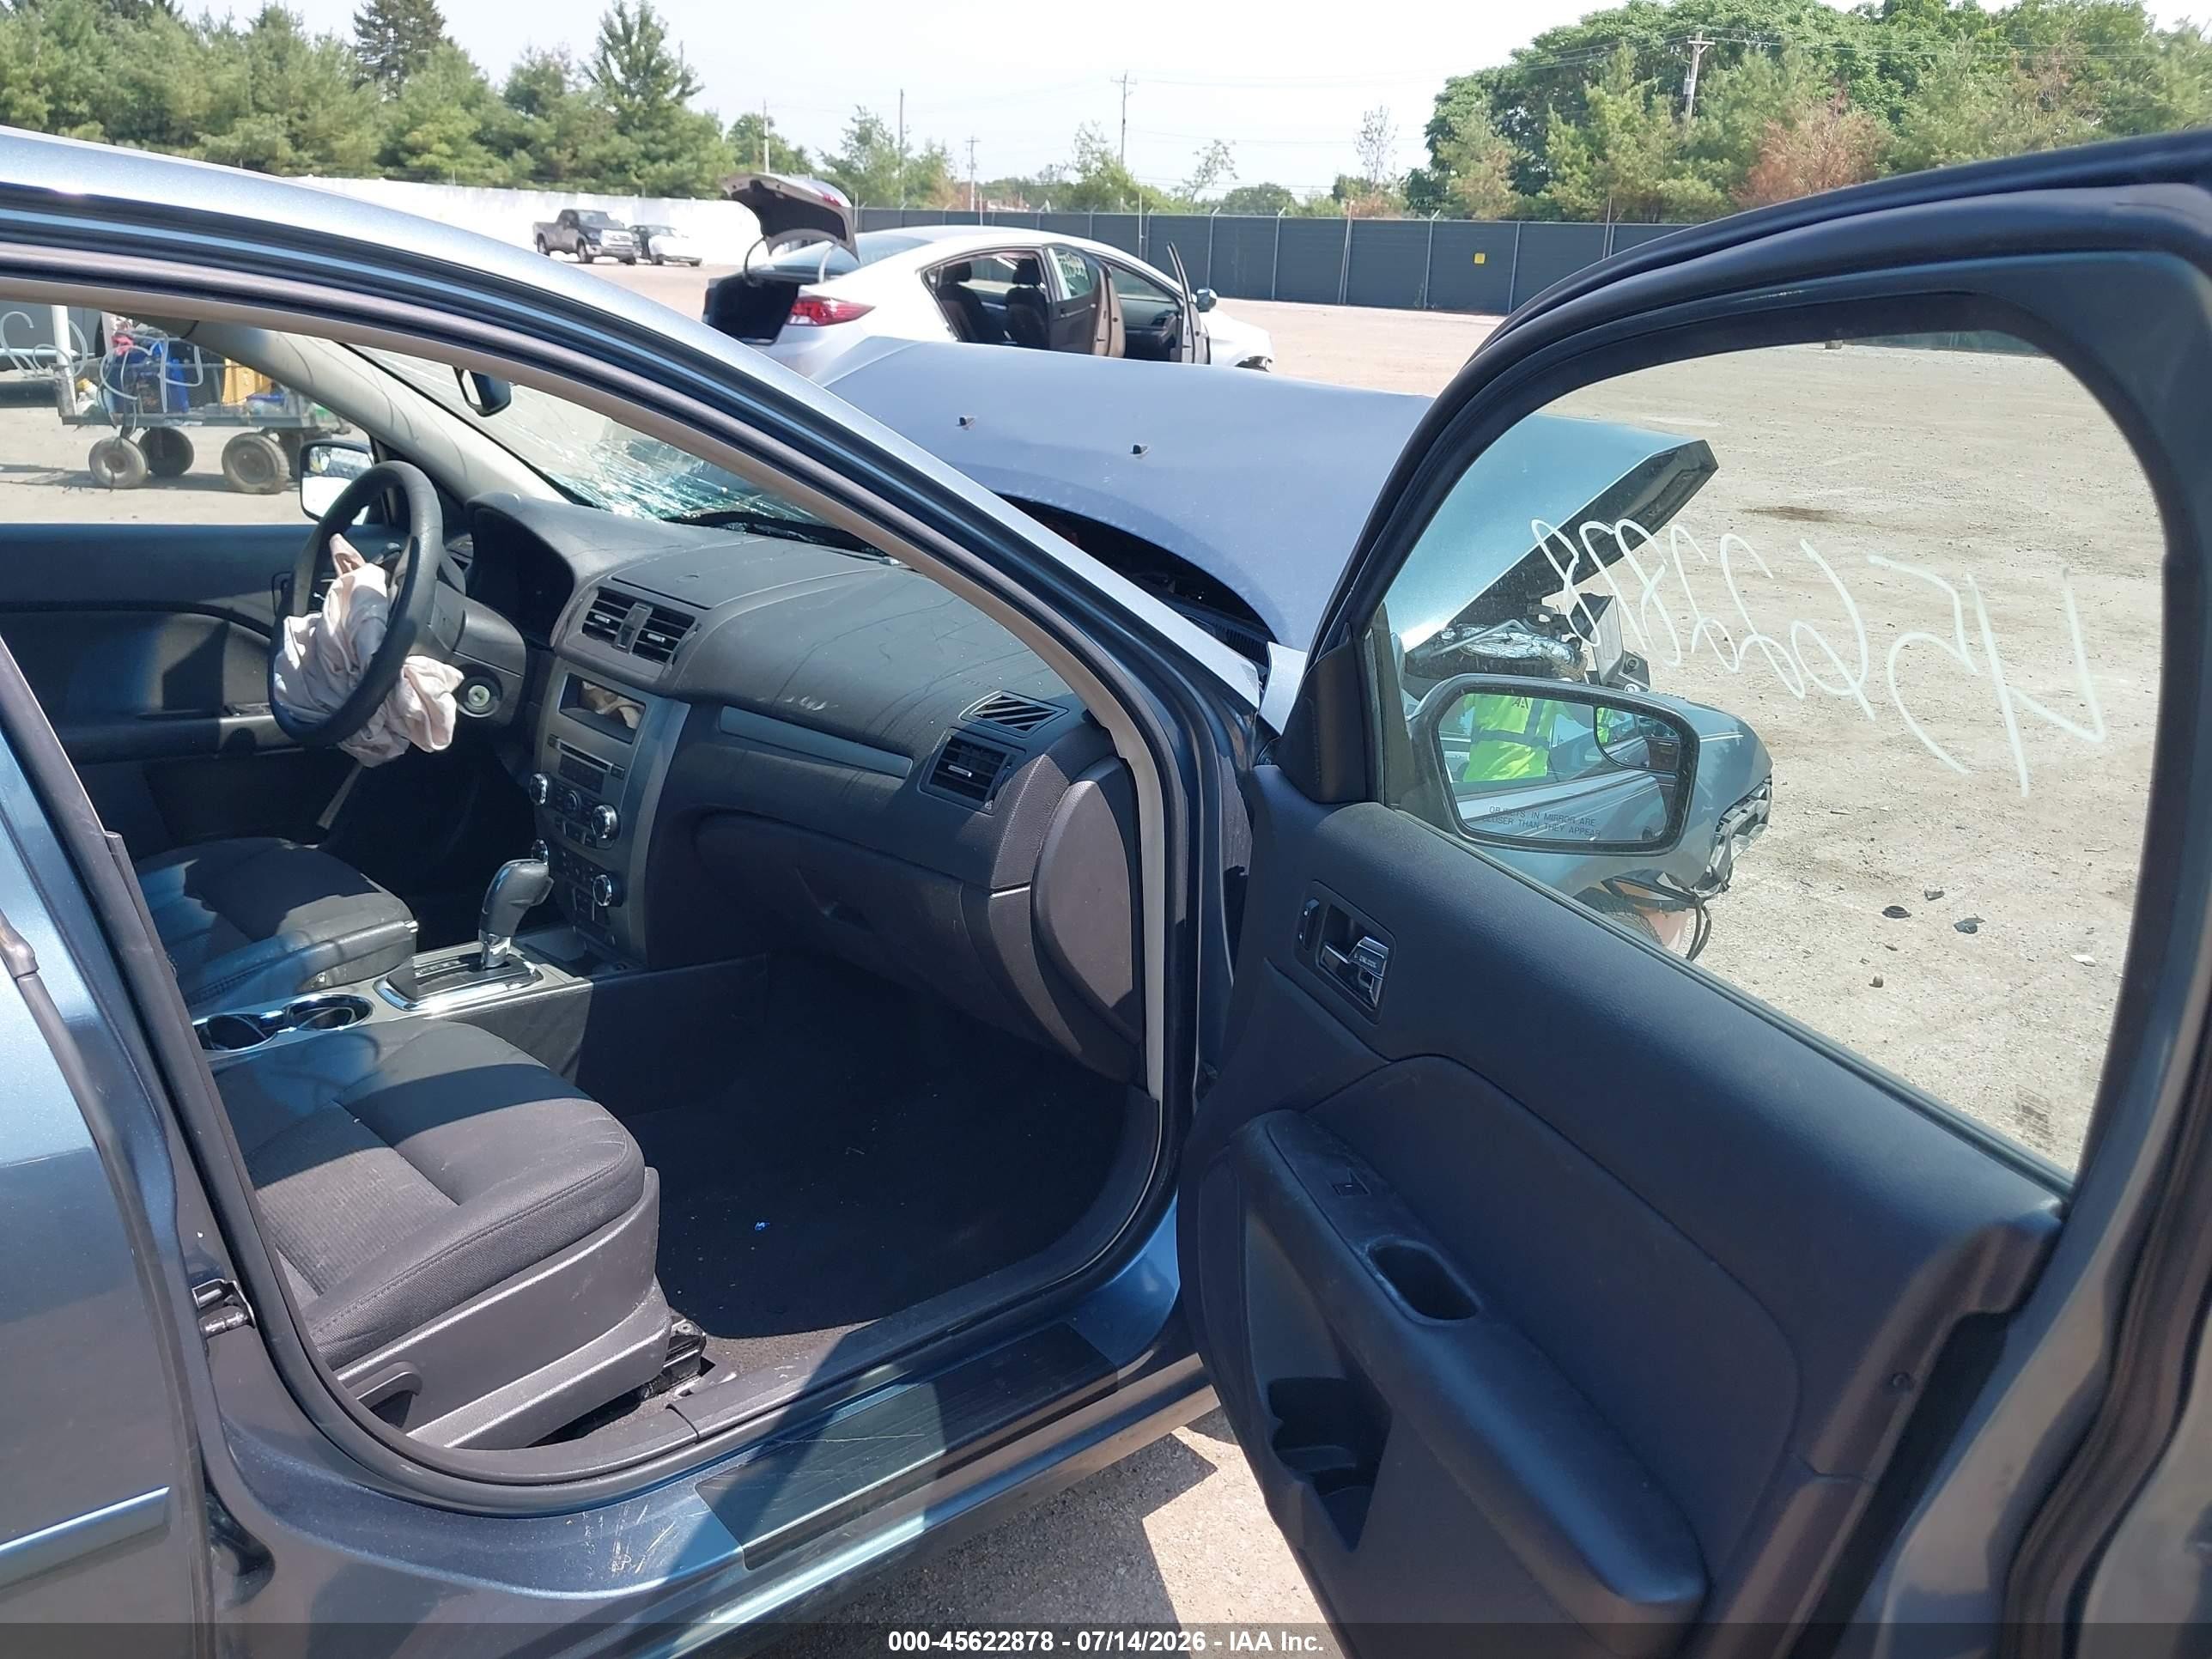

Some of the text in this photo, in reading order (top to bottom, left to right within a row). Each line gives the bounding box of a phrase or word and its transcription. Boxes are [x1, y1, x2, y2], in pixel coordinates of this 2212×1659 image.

[1484, 816, 1601, 837] OSER THAN THEY APPEAR
[1489, 805, 1526, 818] OBTS
[1544, 813, 1576, 824] MIRROR
[1579, 817, 1597, 827] ARE
